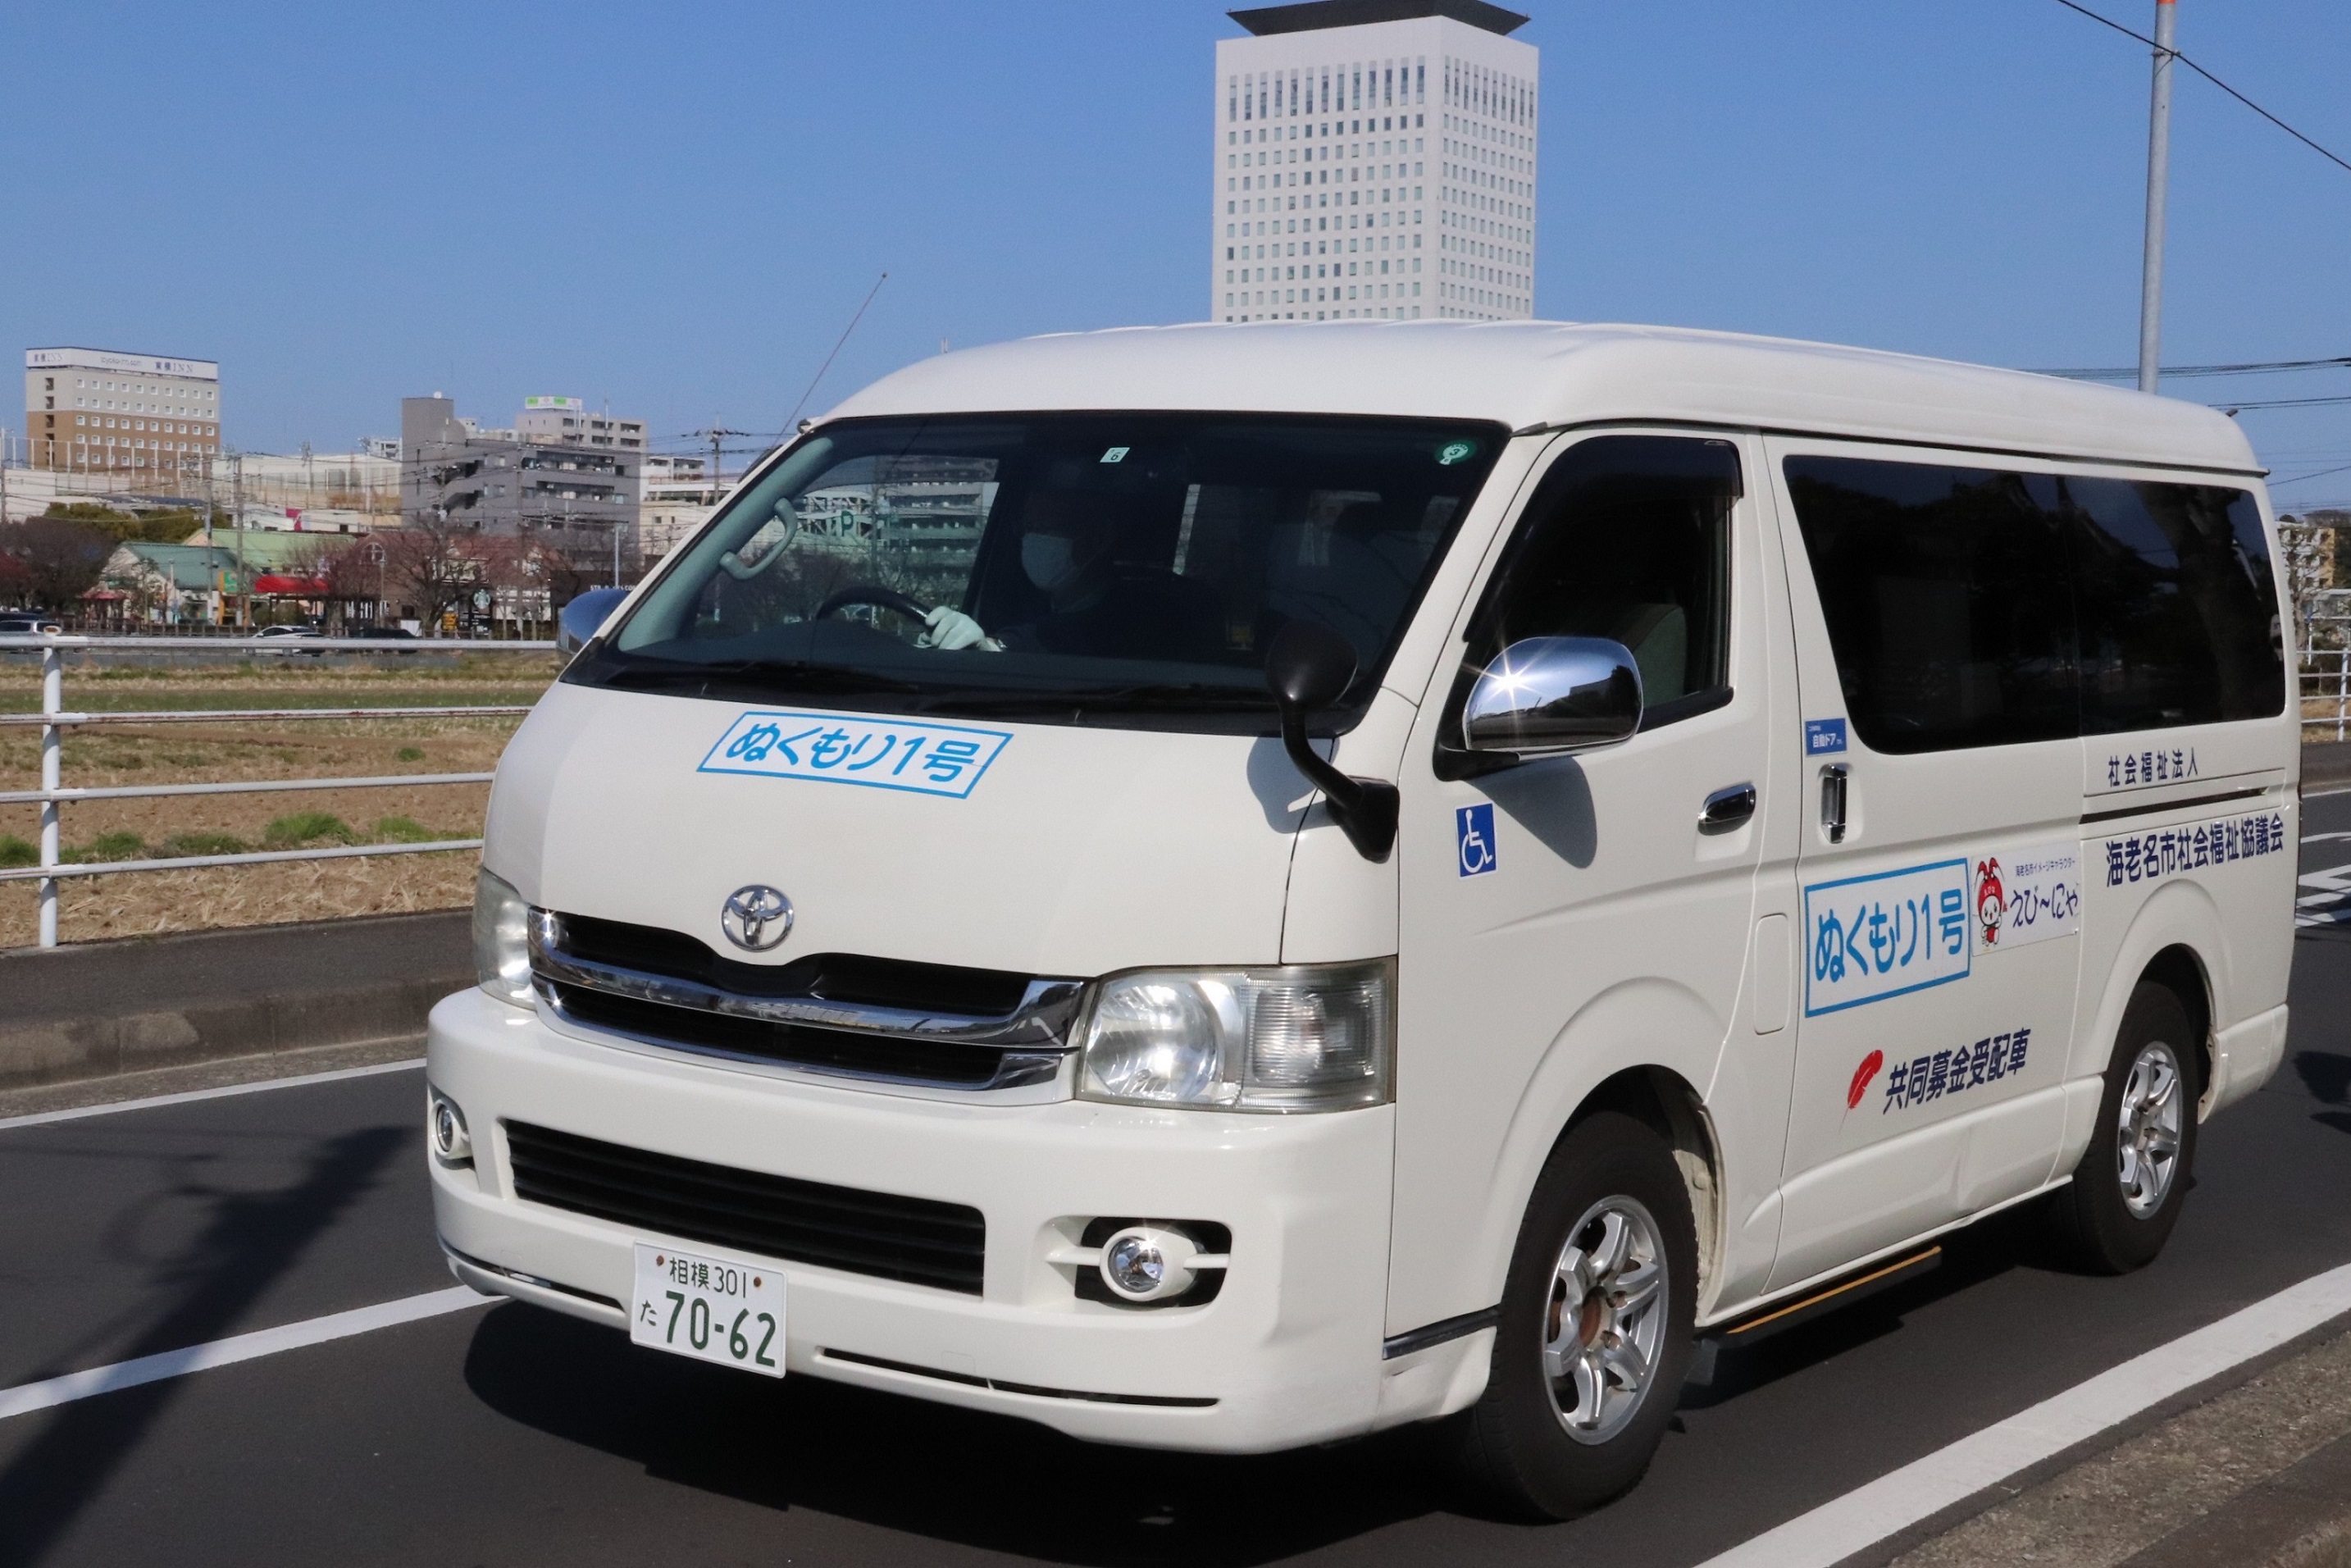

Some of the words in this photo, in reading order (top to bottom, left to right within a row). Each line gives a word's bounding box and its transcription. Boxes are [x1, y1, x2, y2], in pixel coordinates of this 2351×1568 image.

[727, 722, 981, 782] ぬくもり1号
[2107, 747, 2198, 787] 社会福祉法人
[2106, 812, 2284, 888] 海老名市社会福祉協議会
[1815, 888, 1966, 982] ぬくもり1号
[1883, 1027, 2032, 1115] 共同募金受配車
[640, 1300, 658, 1327] た
[666, 1290, 777, 1368] 70-62
